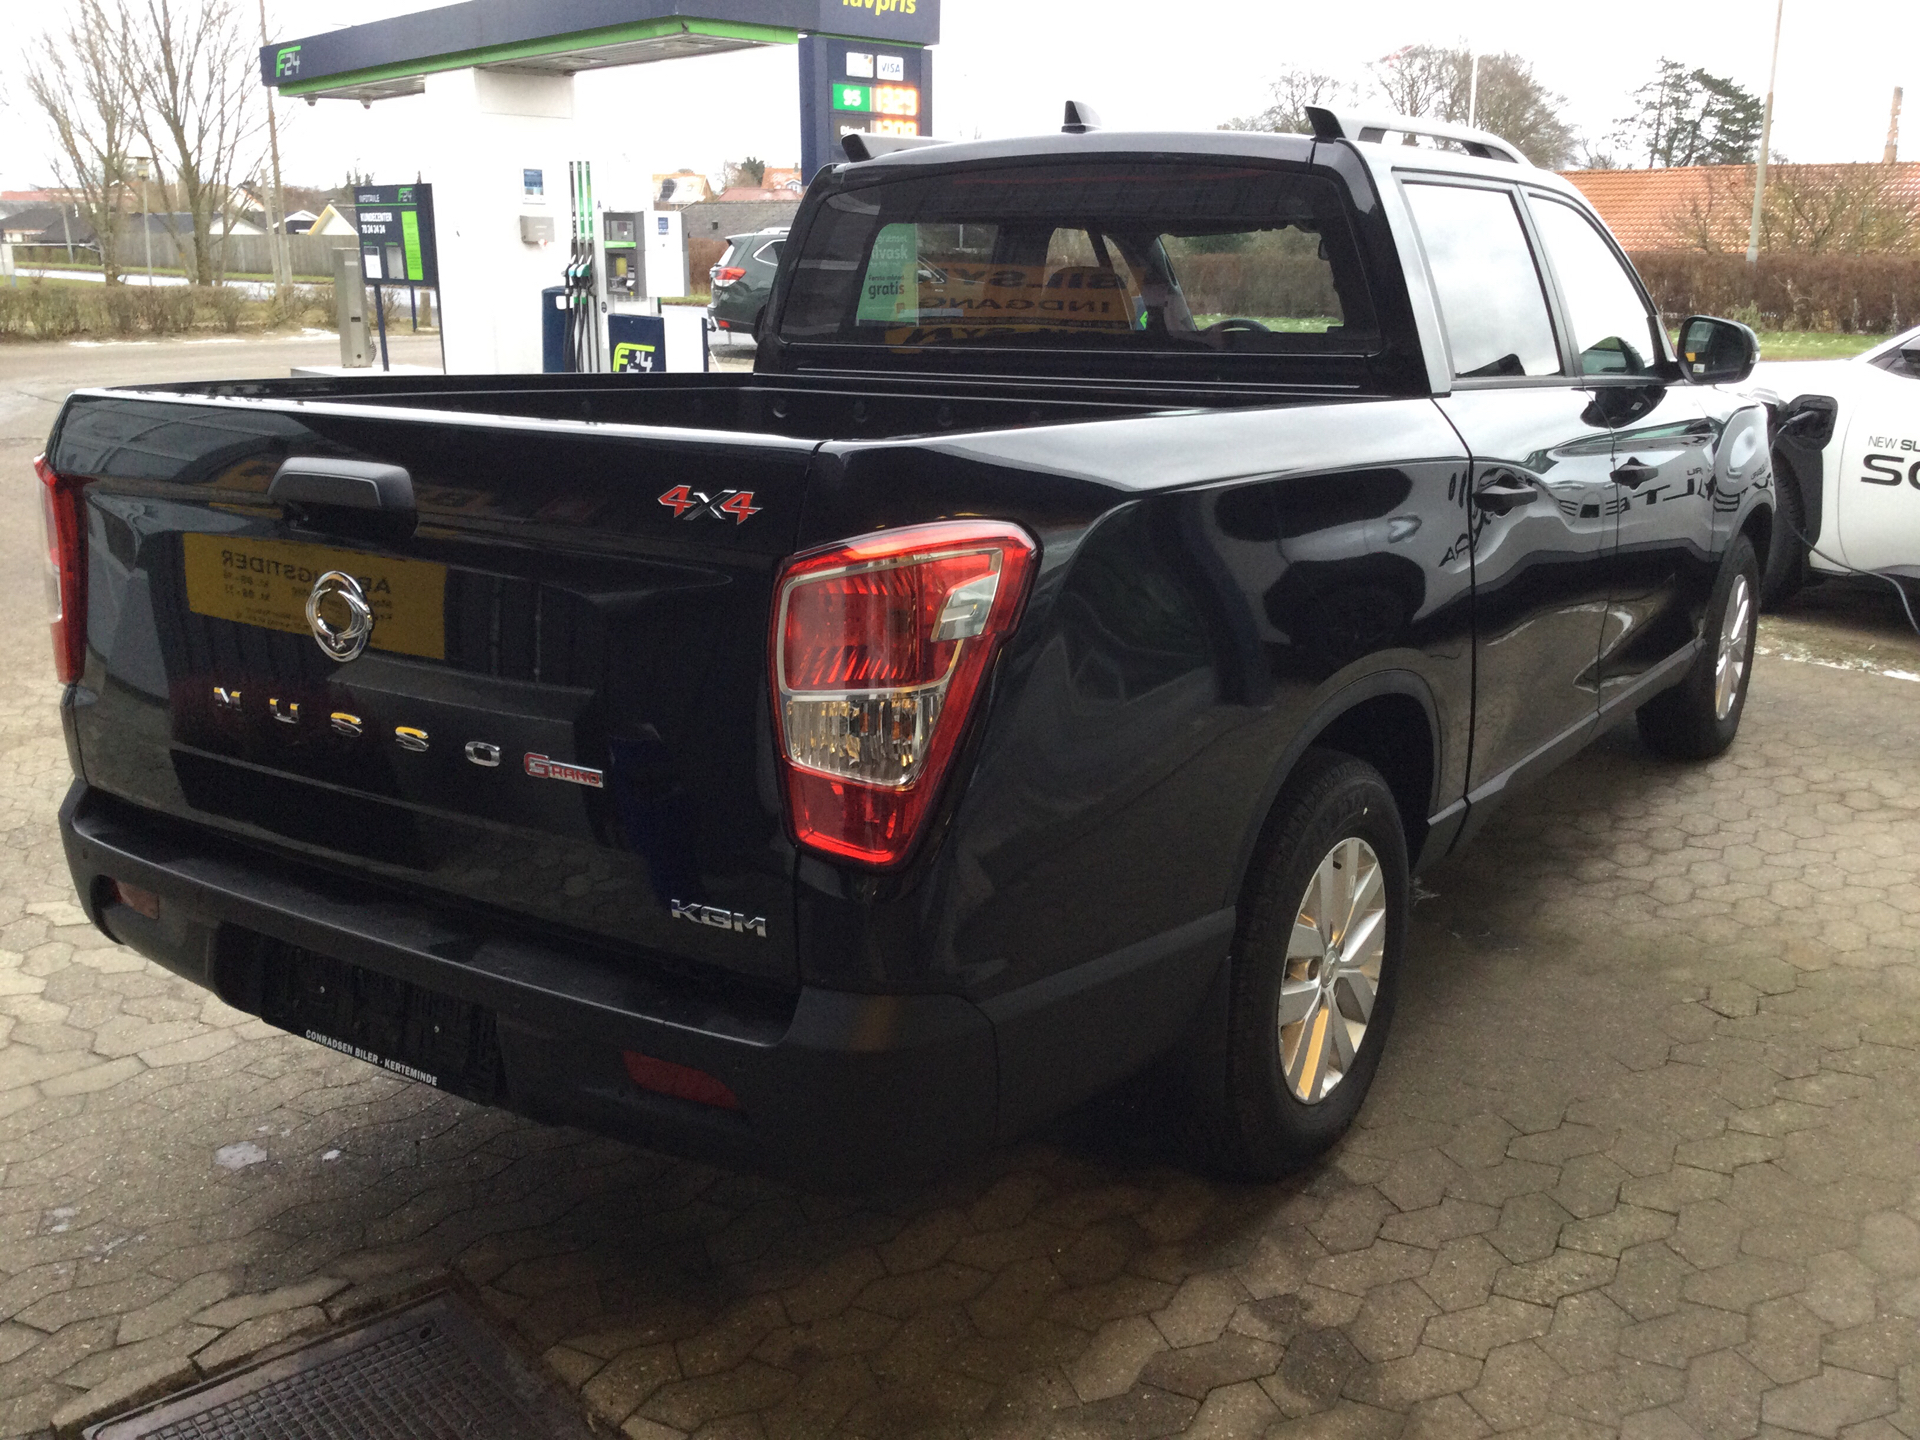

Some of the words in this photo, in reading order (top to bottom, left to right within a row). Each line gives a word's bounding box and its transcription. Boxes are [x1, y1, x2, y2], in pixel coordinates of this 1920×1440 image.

[843, 0, 916, 16] avpris
[276, 45, 302, 77] F24
[881, 62, 901, 73] VISA
[843, 88, 862, 106] 95
[868, 281, 905, 299] gratis
[1867, 435, 1898, 449] NEW
[213, 686, 500, 767] MUSSO
[671, 899, 766, 937] KGM
[305, 1029, 353, 1055] CONRADSEN
[354, 1047, 379, 1065] BILER
[384, 1058, 438, 1087] KERTEMINDE
